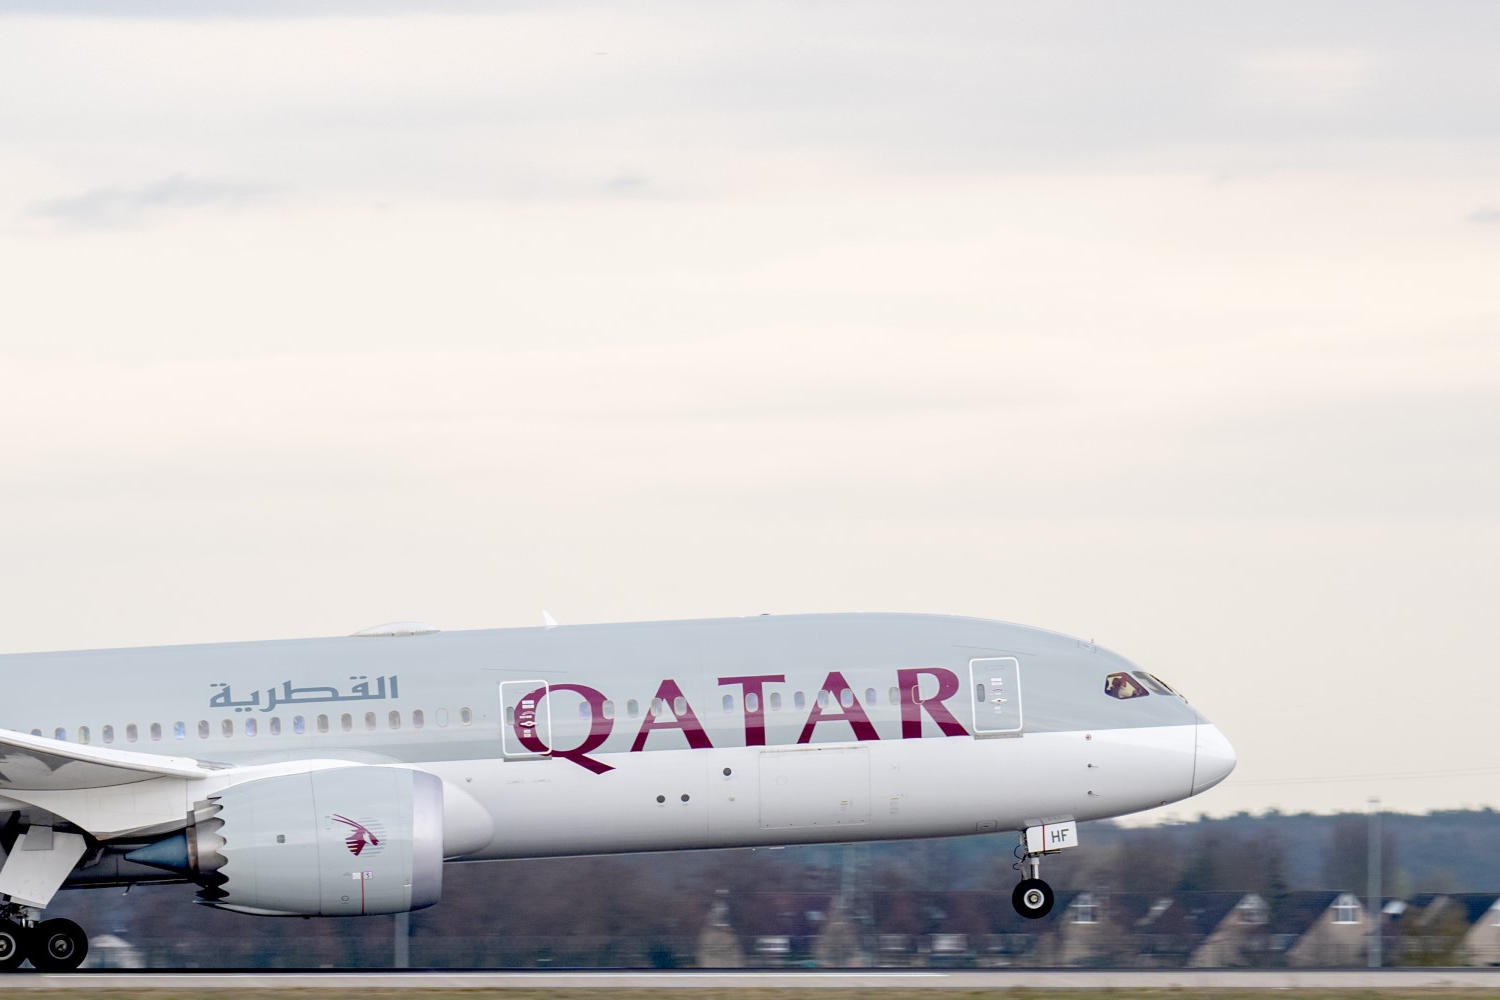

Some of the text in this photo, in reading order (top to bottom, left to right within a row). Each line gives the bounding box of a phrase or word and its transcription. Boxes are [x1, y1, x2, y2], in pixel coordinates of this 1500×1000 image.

[209, 675, 399, 713] القطرية
[514, 667, 970, 775] QATAR
[1051, 828, 1069, 843] HF
